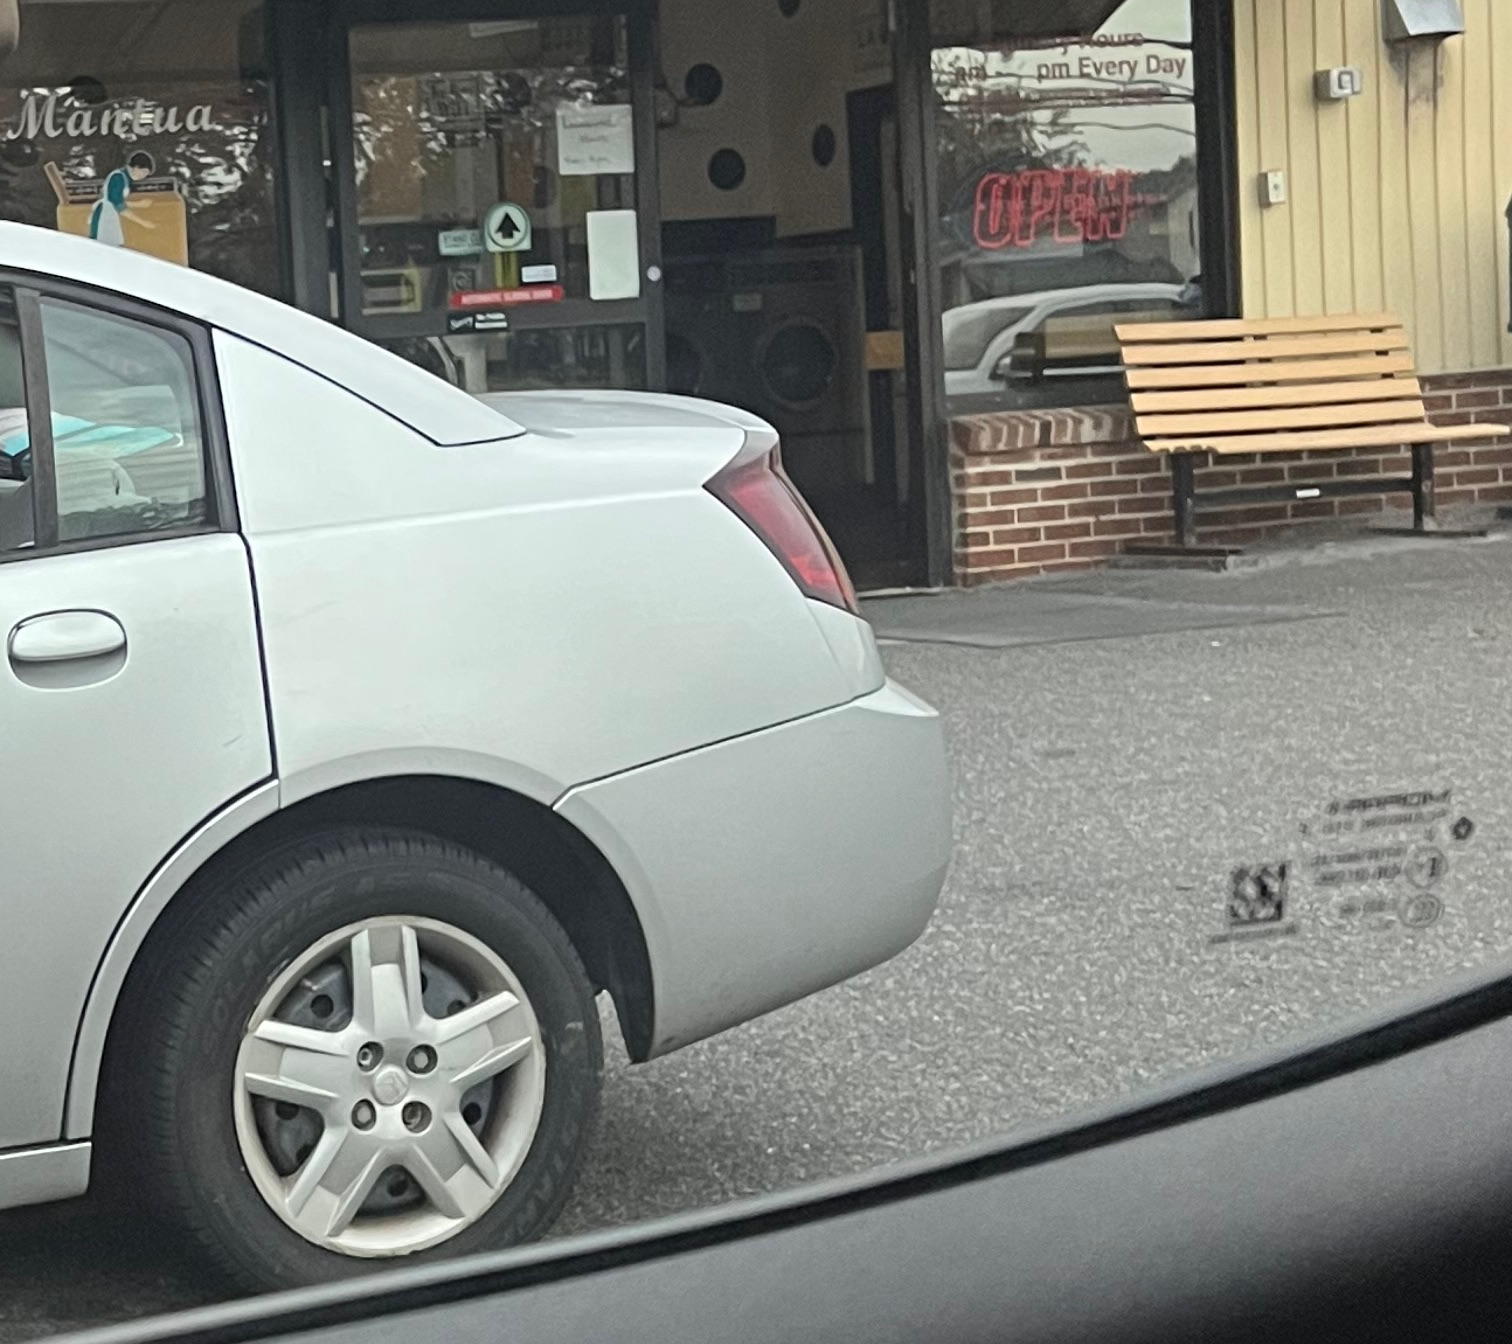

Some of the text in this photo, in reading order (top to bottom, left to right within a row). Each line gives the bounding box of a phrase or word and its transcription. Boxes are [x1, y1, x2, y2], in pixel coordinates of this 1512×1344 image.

[1037, 61, 1071, 84] pm
[1078, 56, 1138, 83] Every
[1146, 54, 1187, 79] Day
[6, 95, 215, 140] Mantua
[973, 167, 1131, 249] OPEN
